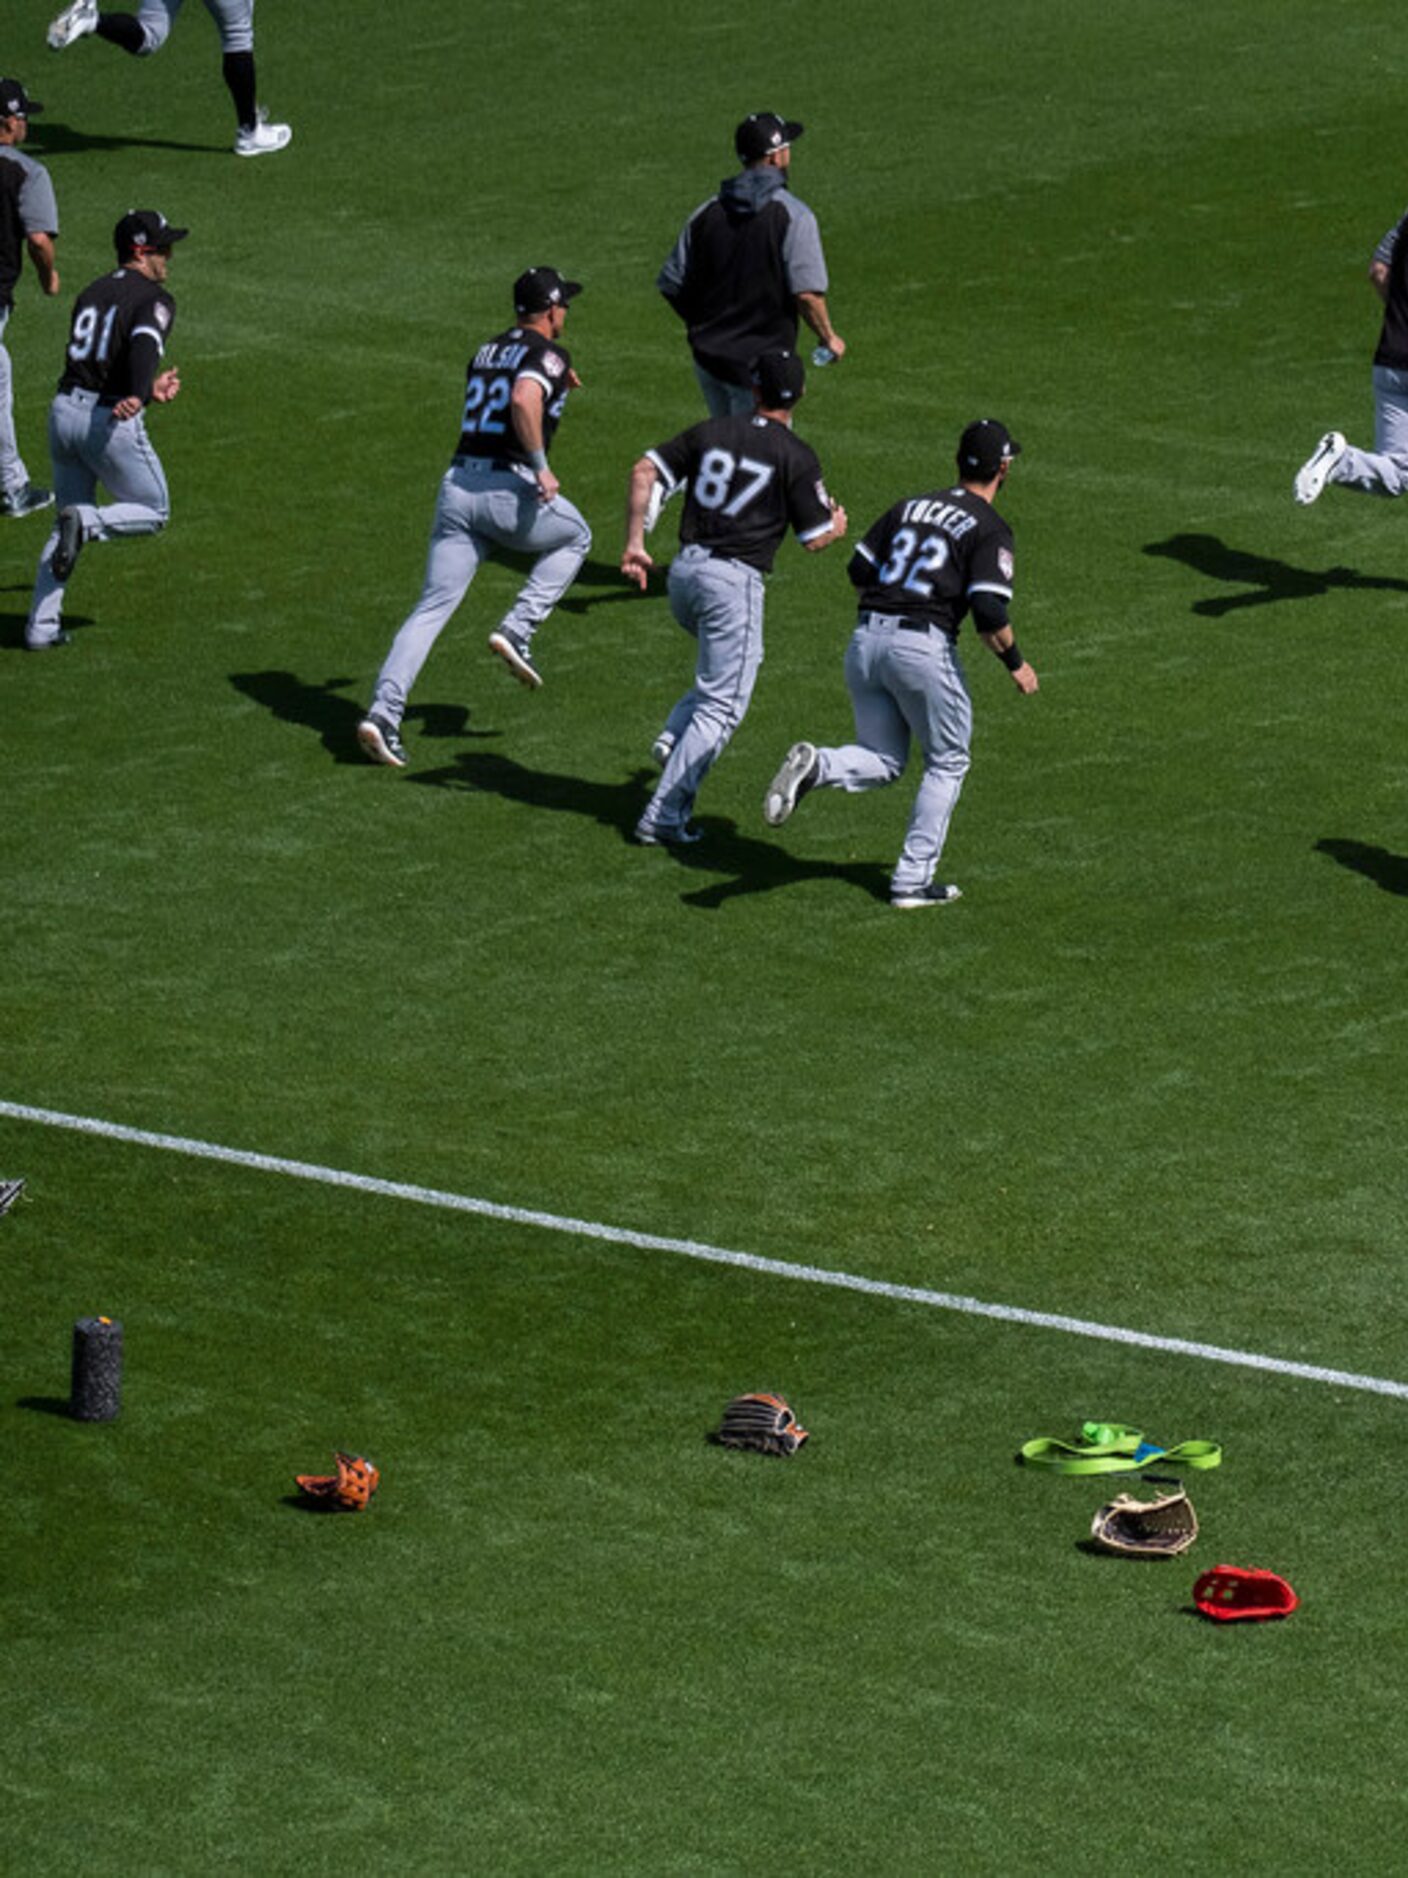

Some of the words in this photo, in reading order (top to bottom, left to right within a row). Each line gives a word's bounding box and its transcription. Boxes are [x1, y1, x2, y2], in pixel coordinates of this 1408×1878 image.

[68, 304, 118, 361] 91
[462, 375, 510, 433] 22
[695, 447, 775, 517] 87
[902, 499, 978, 541] TUCKER
[879, 527, 949, 597] 32
